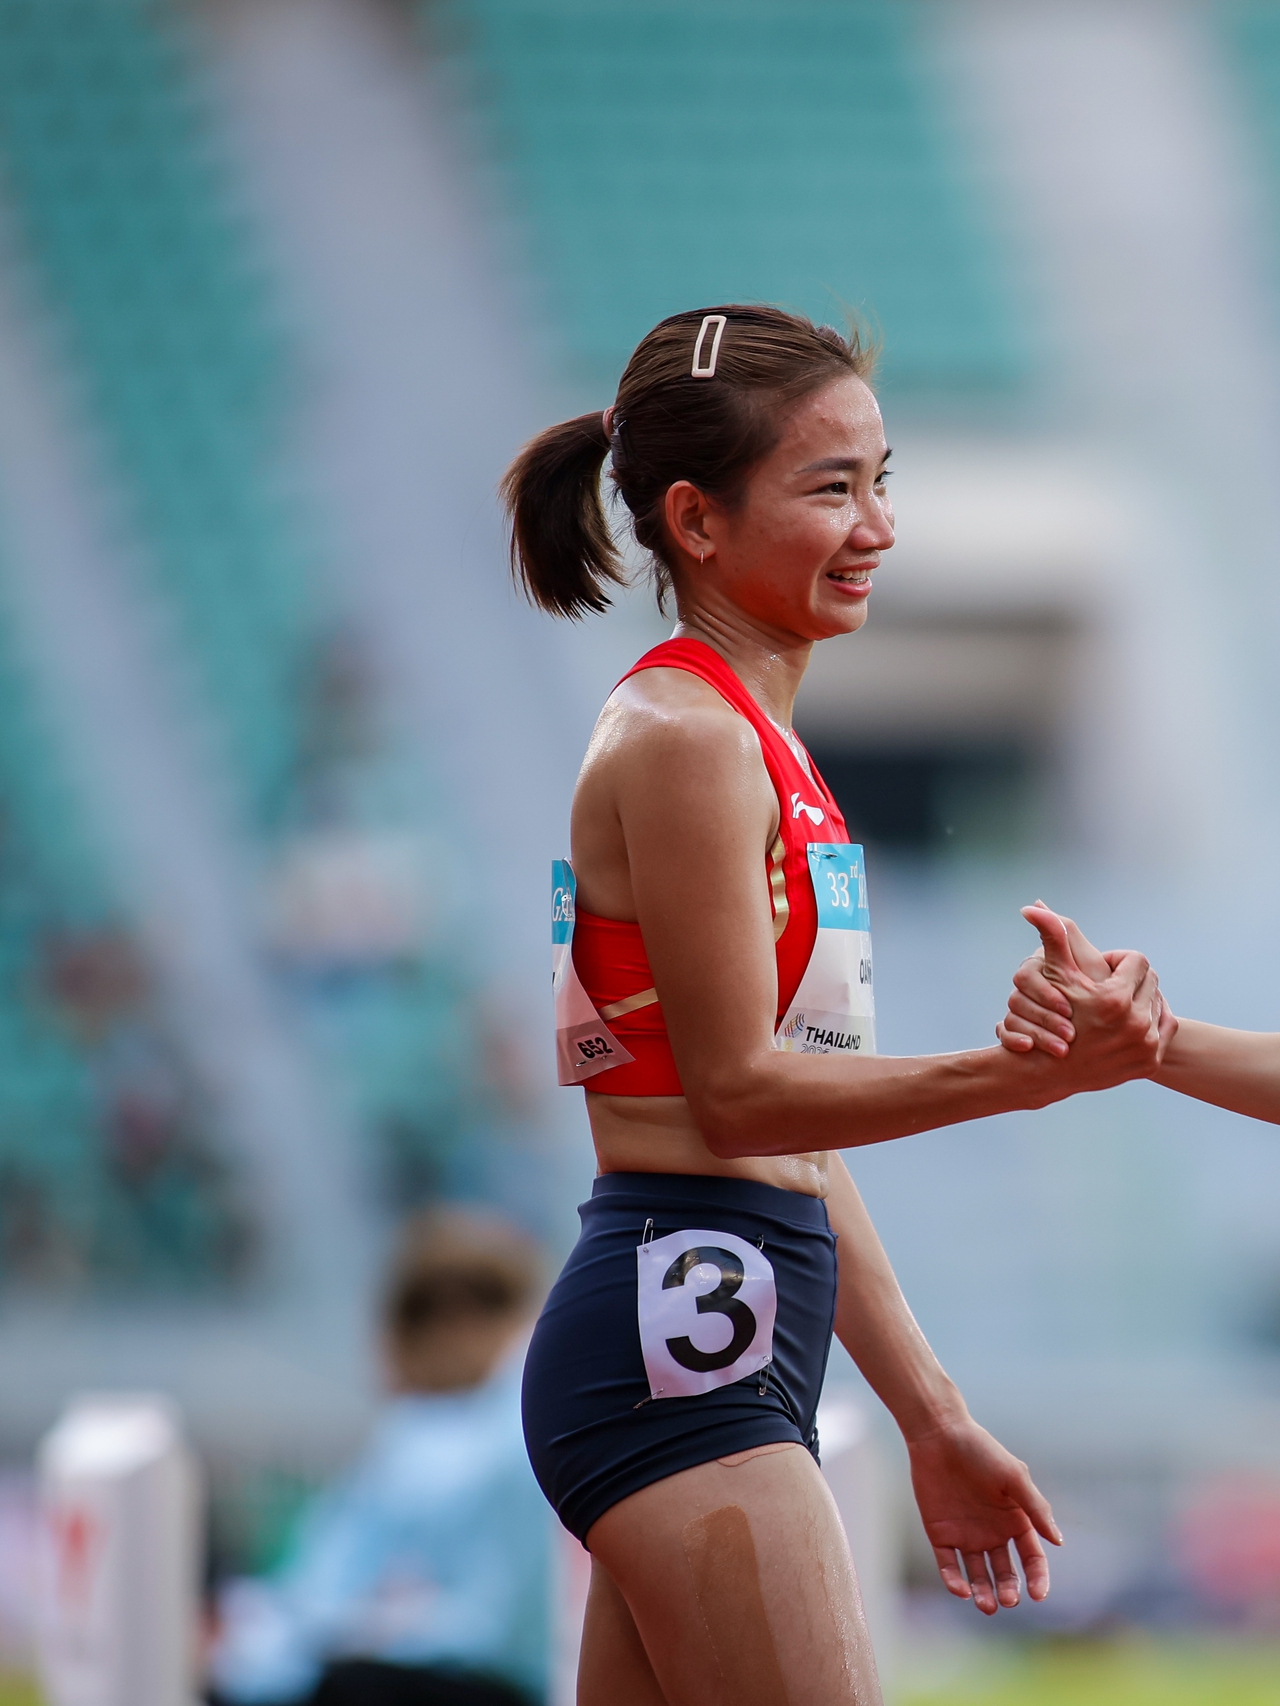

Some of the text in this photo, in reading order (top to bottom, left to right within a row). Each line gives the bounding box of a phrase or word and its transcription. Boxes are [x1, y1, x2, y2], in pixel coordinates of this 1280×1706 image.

[577, 1036, 614, 1059] 652
[806, 1026, 862, 1050] THAILAND
[661, 1246, 757, 1373] 3
